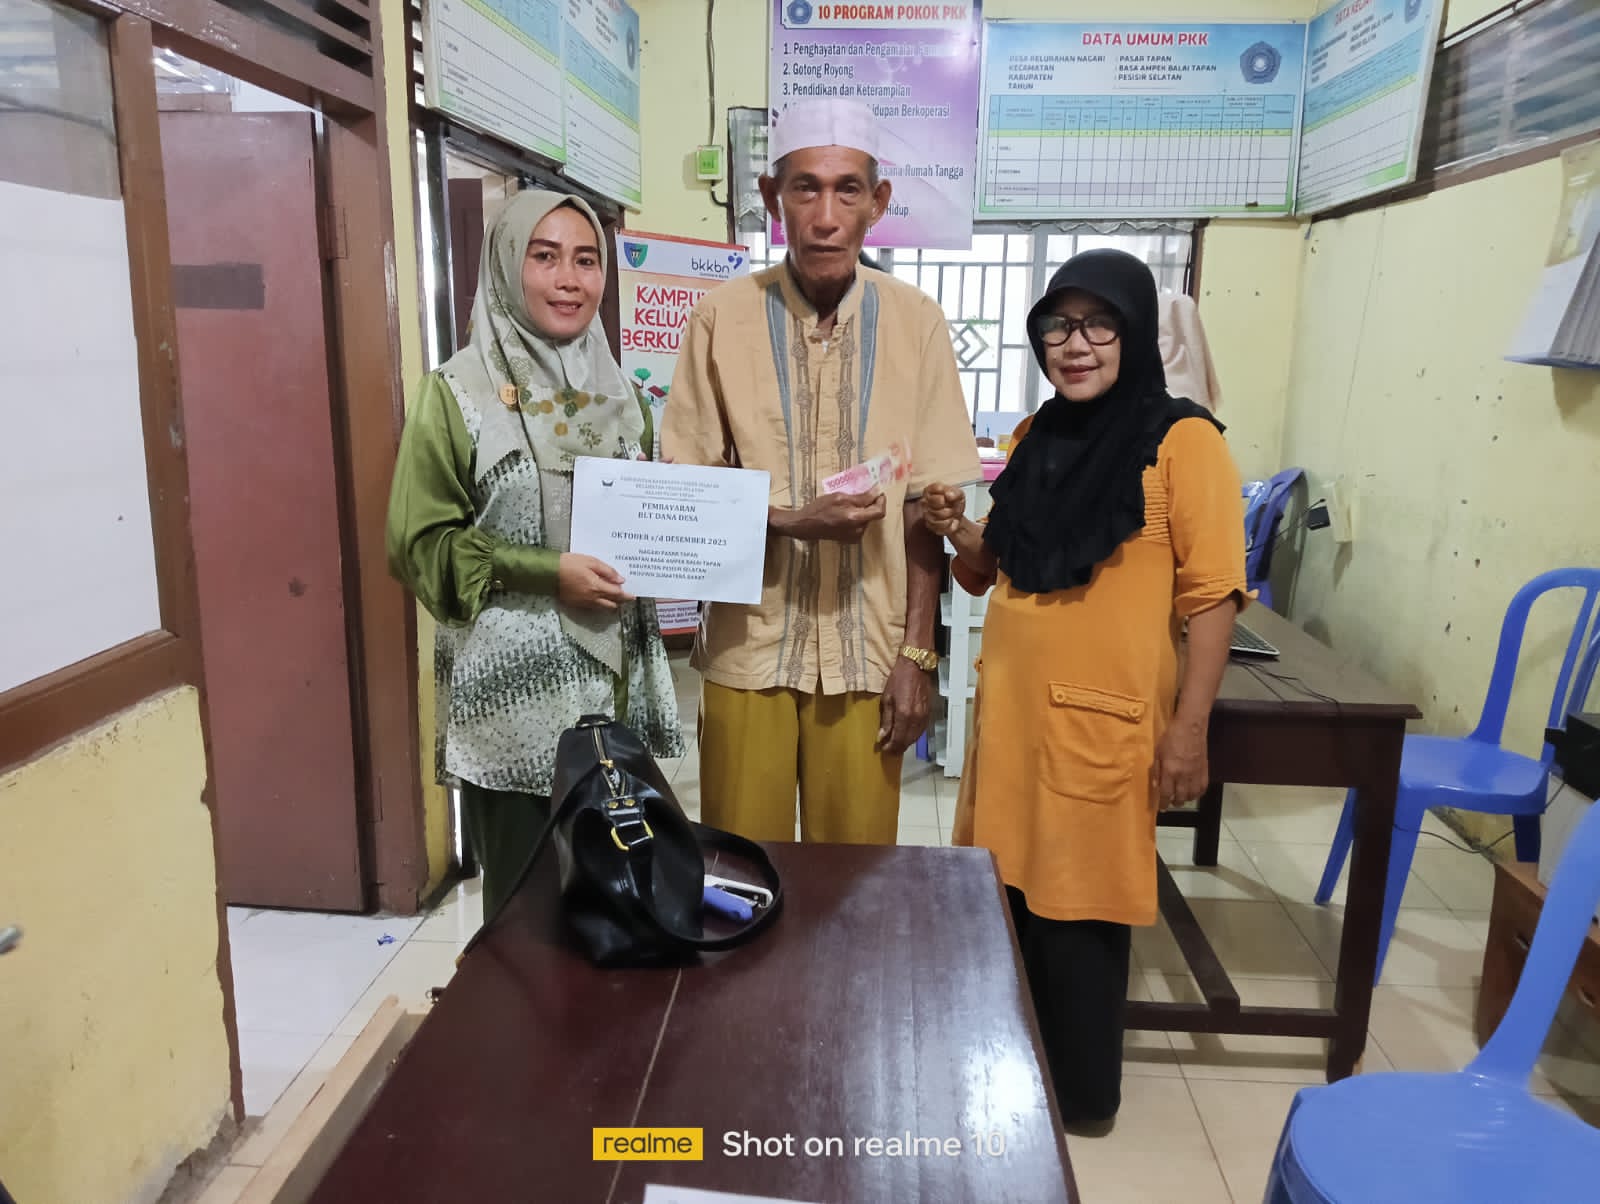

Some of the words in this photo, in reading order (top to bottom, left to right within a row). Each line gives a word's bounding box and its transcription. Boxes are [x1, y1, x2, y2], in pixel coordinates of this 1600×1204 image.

[819, 5, 831, 20] 10
[834, 5, 894, 20] PROGRAM
[897, 5, 938, 20] POKOK
[943, 5, 967, 20] PKK
[1082, 32, 1122, 45] DATA
[1127, 32, 1173, 45] UMUM
[1178, 32, 1208, 45] PKK
[783, 43, 791, 54] 1.
[793, 43, 846, 57] Penghayatan
[848, 43, 863, 54] dan
[783, 63, 791, 75] 2.
[793, 63, 821, 78] Gotong
[824, 63, 854, 78] Royong
[783, 83, 791, 95] 3.
[793, 83, 837, 95] Pendidikan
[840, 83, 854, 96] dan
[857, 84, 911, 98] Keterampilan
[872, 104, 899, 118] idupan
[901, 104, 950, 118] Berkoperasi
[880, 165, 902, 177] ksana
[904, 164, 933, 177] Rumah
[935, 164, 964, 180] Tangga
[886, 204, 908, 217] Hidup
[691, 256, 730, 272] bkkbn
[636, 285, 704, 307] KAMPU
[635, 307, 688, 329] KELUA
[622, 328, 680, 349] BERKU
[641, 502, 696, 512] PEMBAYARAN
[638, 511, 653, 519] BLT
[655, 512, 677, 521] DANA
[678, 514, 698, 522] DESA
[611, 531, 649, 541] OKTOBER
[650, 535, 664, 543] s/d
[665, 535, 706, 545] DESEMBER
[707, 537, 727, 546] 2023
[629, 563, 661, 571] KABUPATEN
